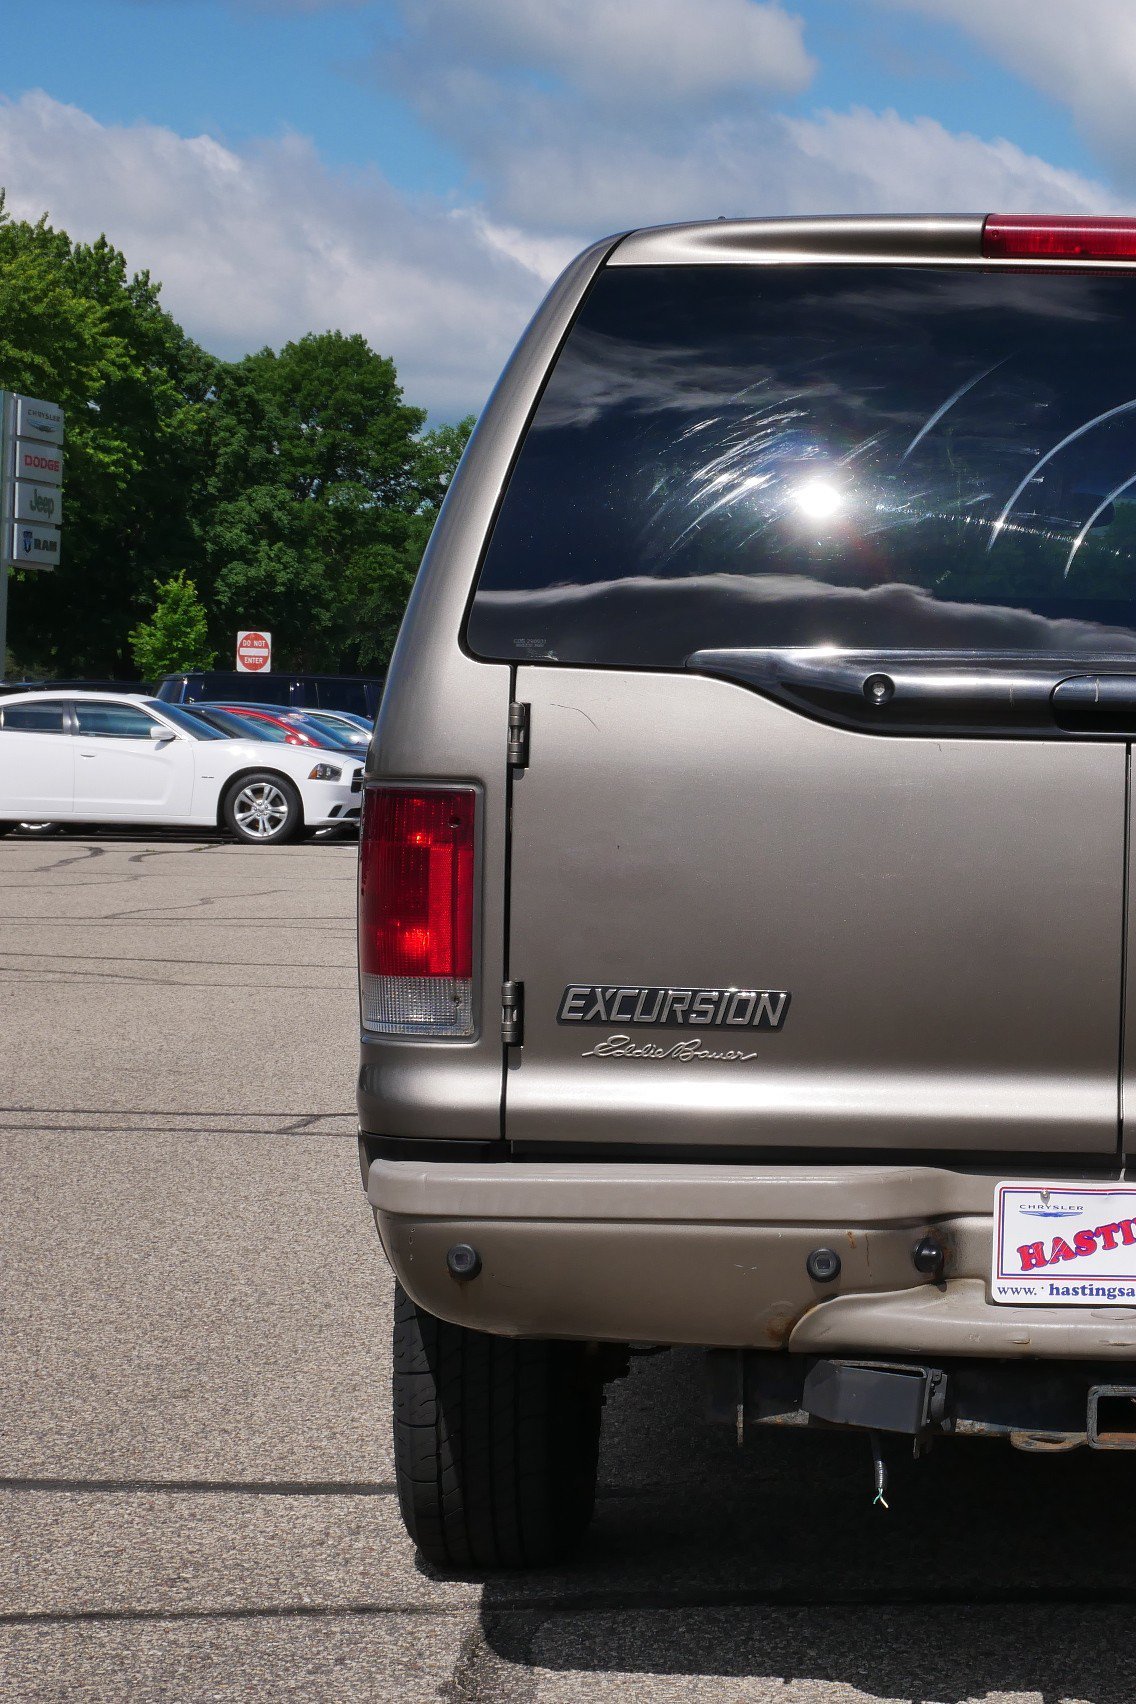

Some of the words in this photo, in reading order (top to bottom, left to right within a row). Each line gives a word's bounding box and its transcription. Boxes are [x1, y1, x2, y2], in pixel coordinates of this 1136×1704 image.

[27, 409, 61, 421] CHRYSLER
[24, 454, 60, 471] DODGE
[30, 488, 54, 519] Jeep
[33, 538, 58, 552] RAM
[244, 656, 263, 664] ENTER
[560, 988, 787, 1026] EXCURSION
